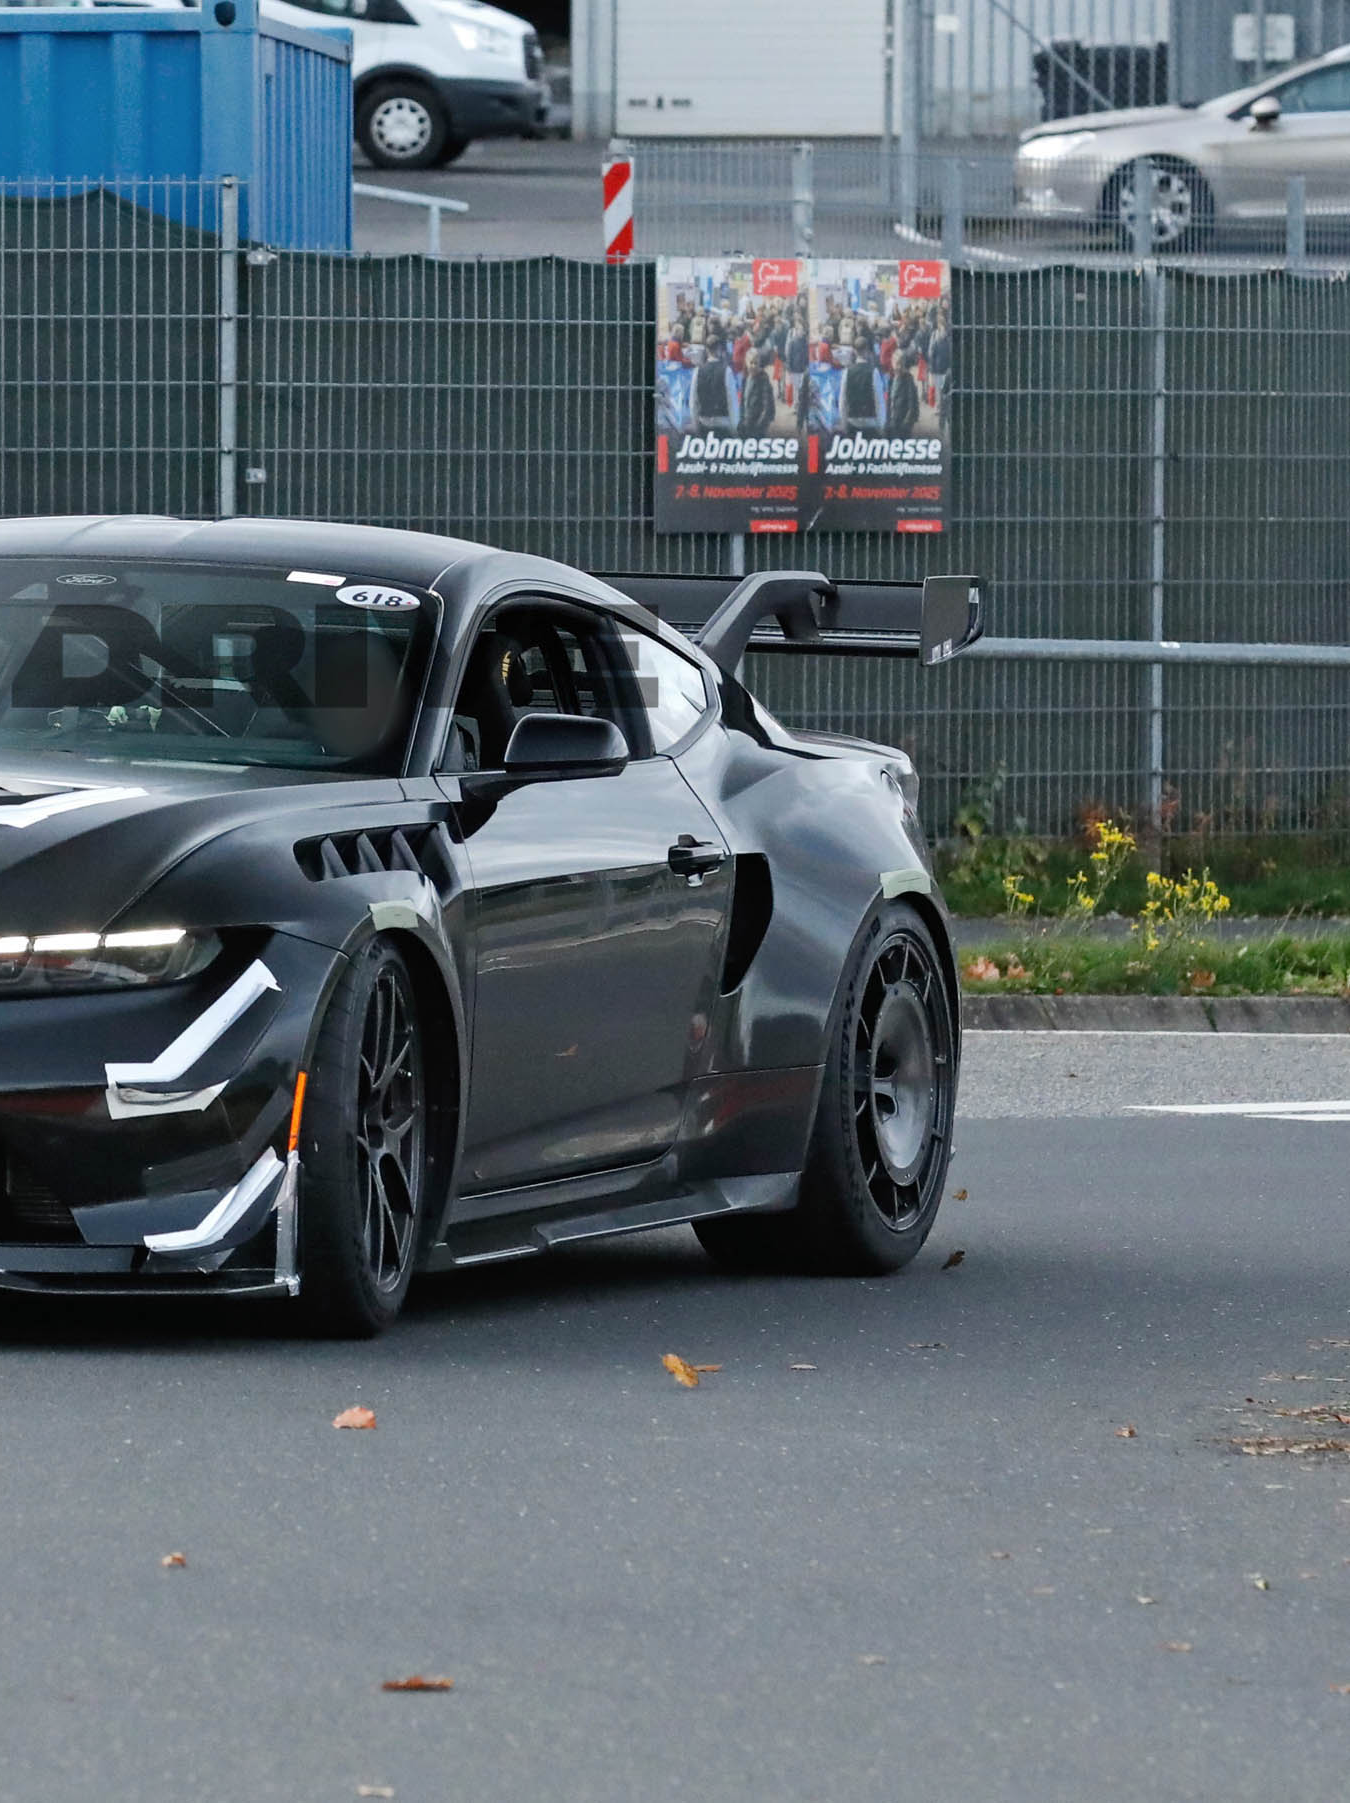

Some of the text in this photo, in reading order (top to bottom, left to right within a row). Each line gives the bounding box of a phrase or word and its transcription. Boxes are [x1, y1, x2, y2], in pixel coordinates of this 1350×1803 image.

[676, 431, 799, 459] Jobmesse
[825, 431, 942, 460] Jobmesse
[676, 461, 708, 474] Azubi-
[703, 485, 765, 499] November
[851, 485, 910, 499] November
[352, 591, 403, 607] 618
